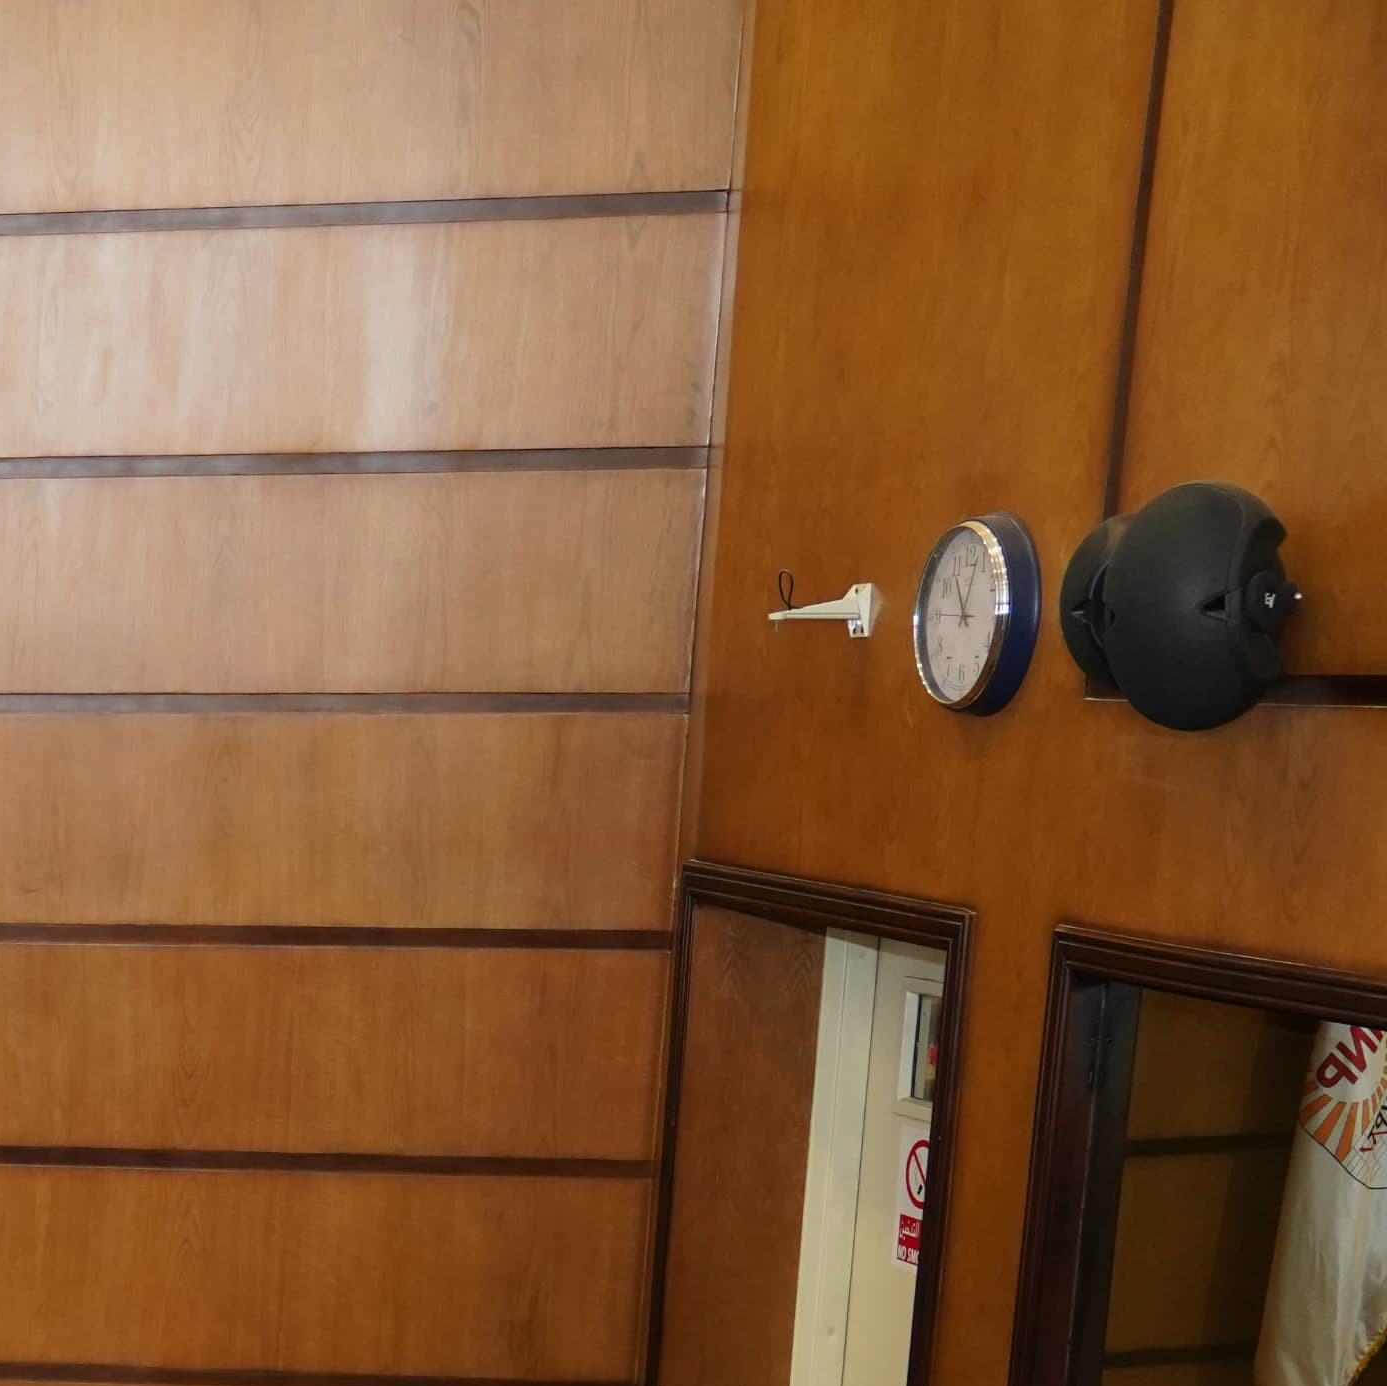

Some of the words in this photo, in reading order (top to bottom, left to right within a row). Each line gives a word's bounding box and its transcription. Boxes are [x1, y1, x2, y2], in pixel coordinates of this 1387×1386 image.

[952, 556, 961, 577] 11
[965, 545, 978, 567] 12
[942, 577, 952, 599] 10
[897, 1244, 907, 1259] NO
